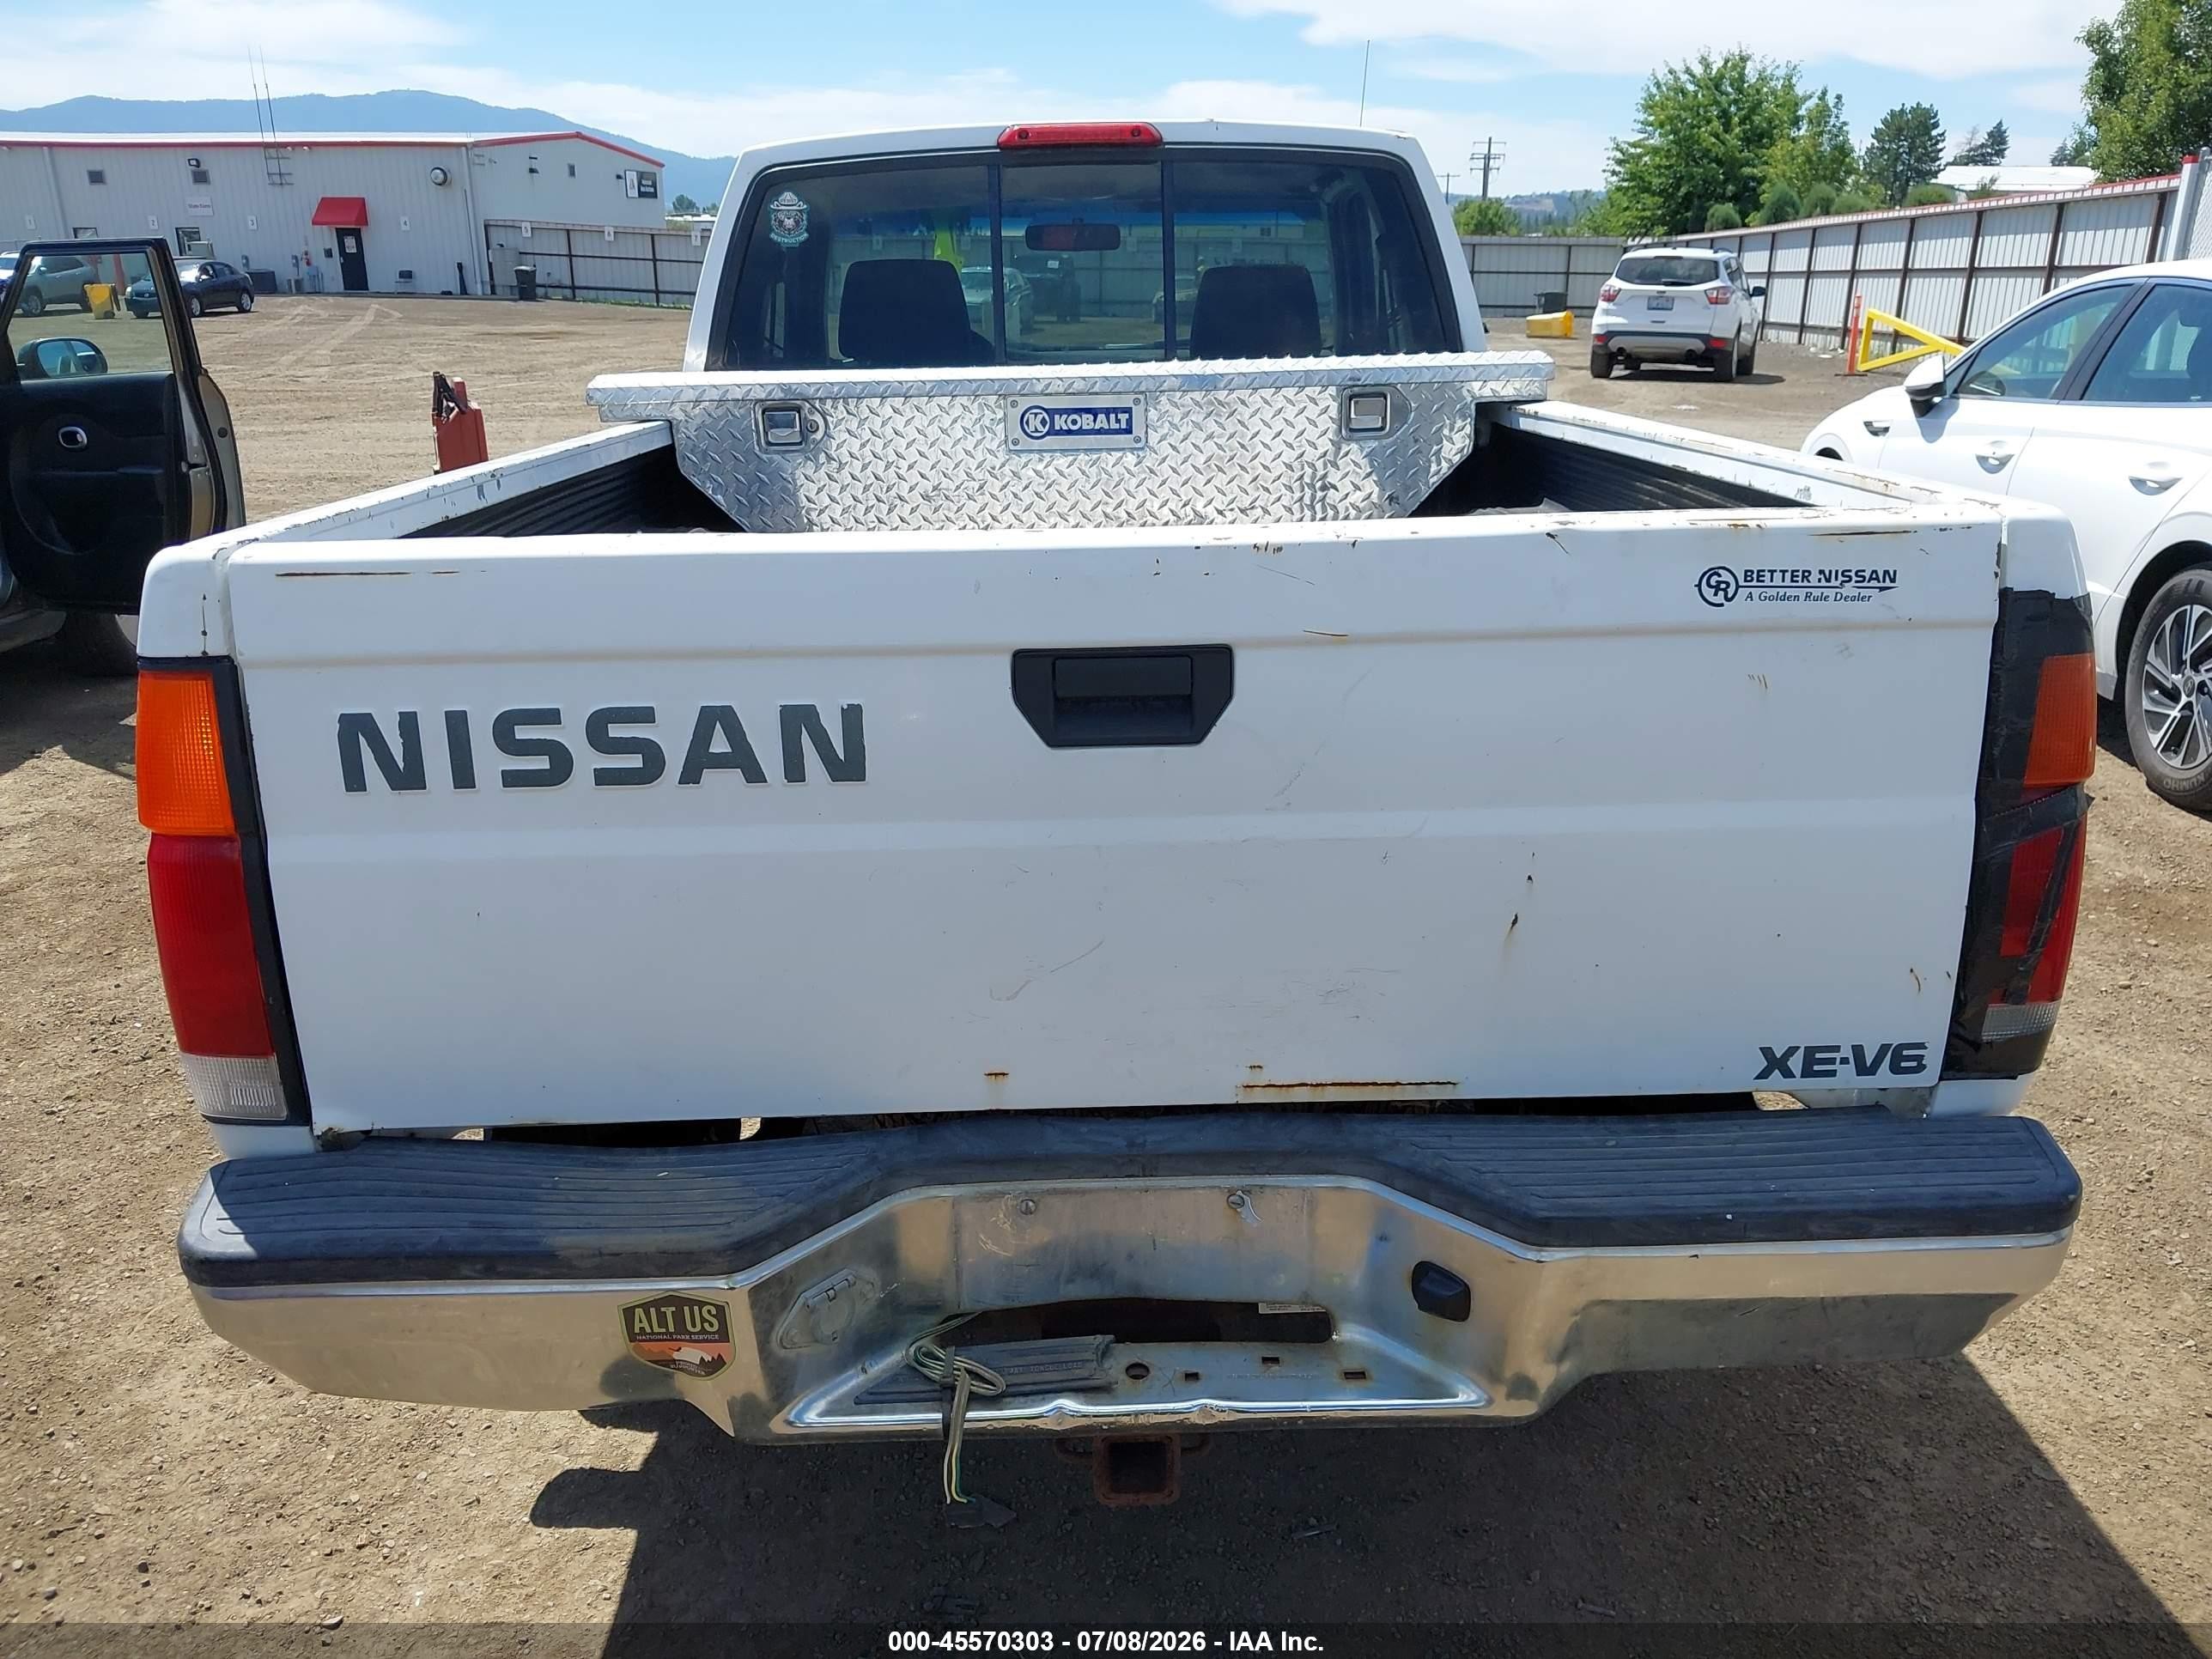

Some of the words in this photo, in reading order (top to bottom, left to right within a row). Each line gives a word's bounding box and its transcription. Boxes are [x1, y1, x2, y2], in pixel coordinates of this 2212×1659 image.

[1054, 413, 1129, 430] KOBALT
[1743, 568, 1813, 583] BETTER
[1817, 568, 1898, 584] NISSAN
[1744, 591, 1753, 602] A
[1758, 591, 1800, 602] Golden
[1804, 591, 1830, 602] Rule
[1833, 591, 1873, 602] Dealer
[337, 703, 867, 793] NISSAN
[2163, 773, 2205, 791] KUMHO
[1753, 1042, 1929, 1080] XE-V6
[634, 1306, 676, 1333] ALT
[684, 1305, 720, 1333] US
